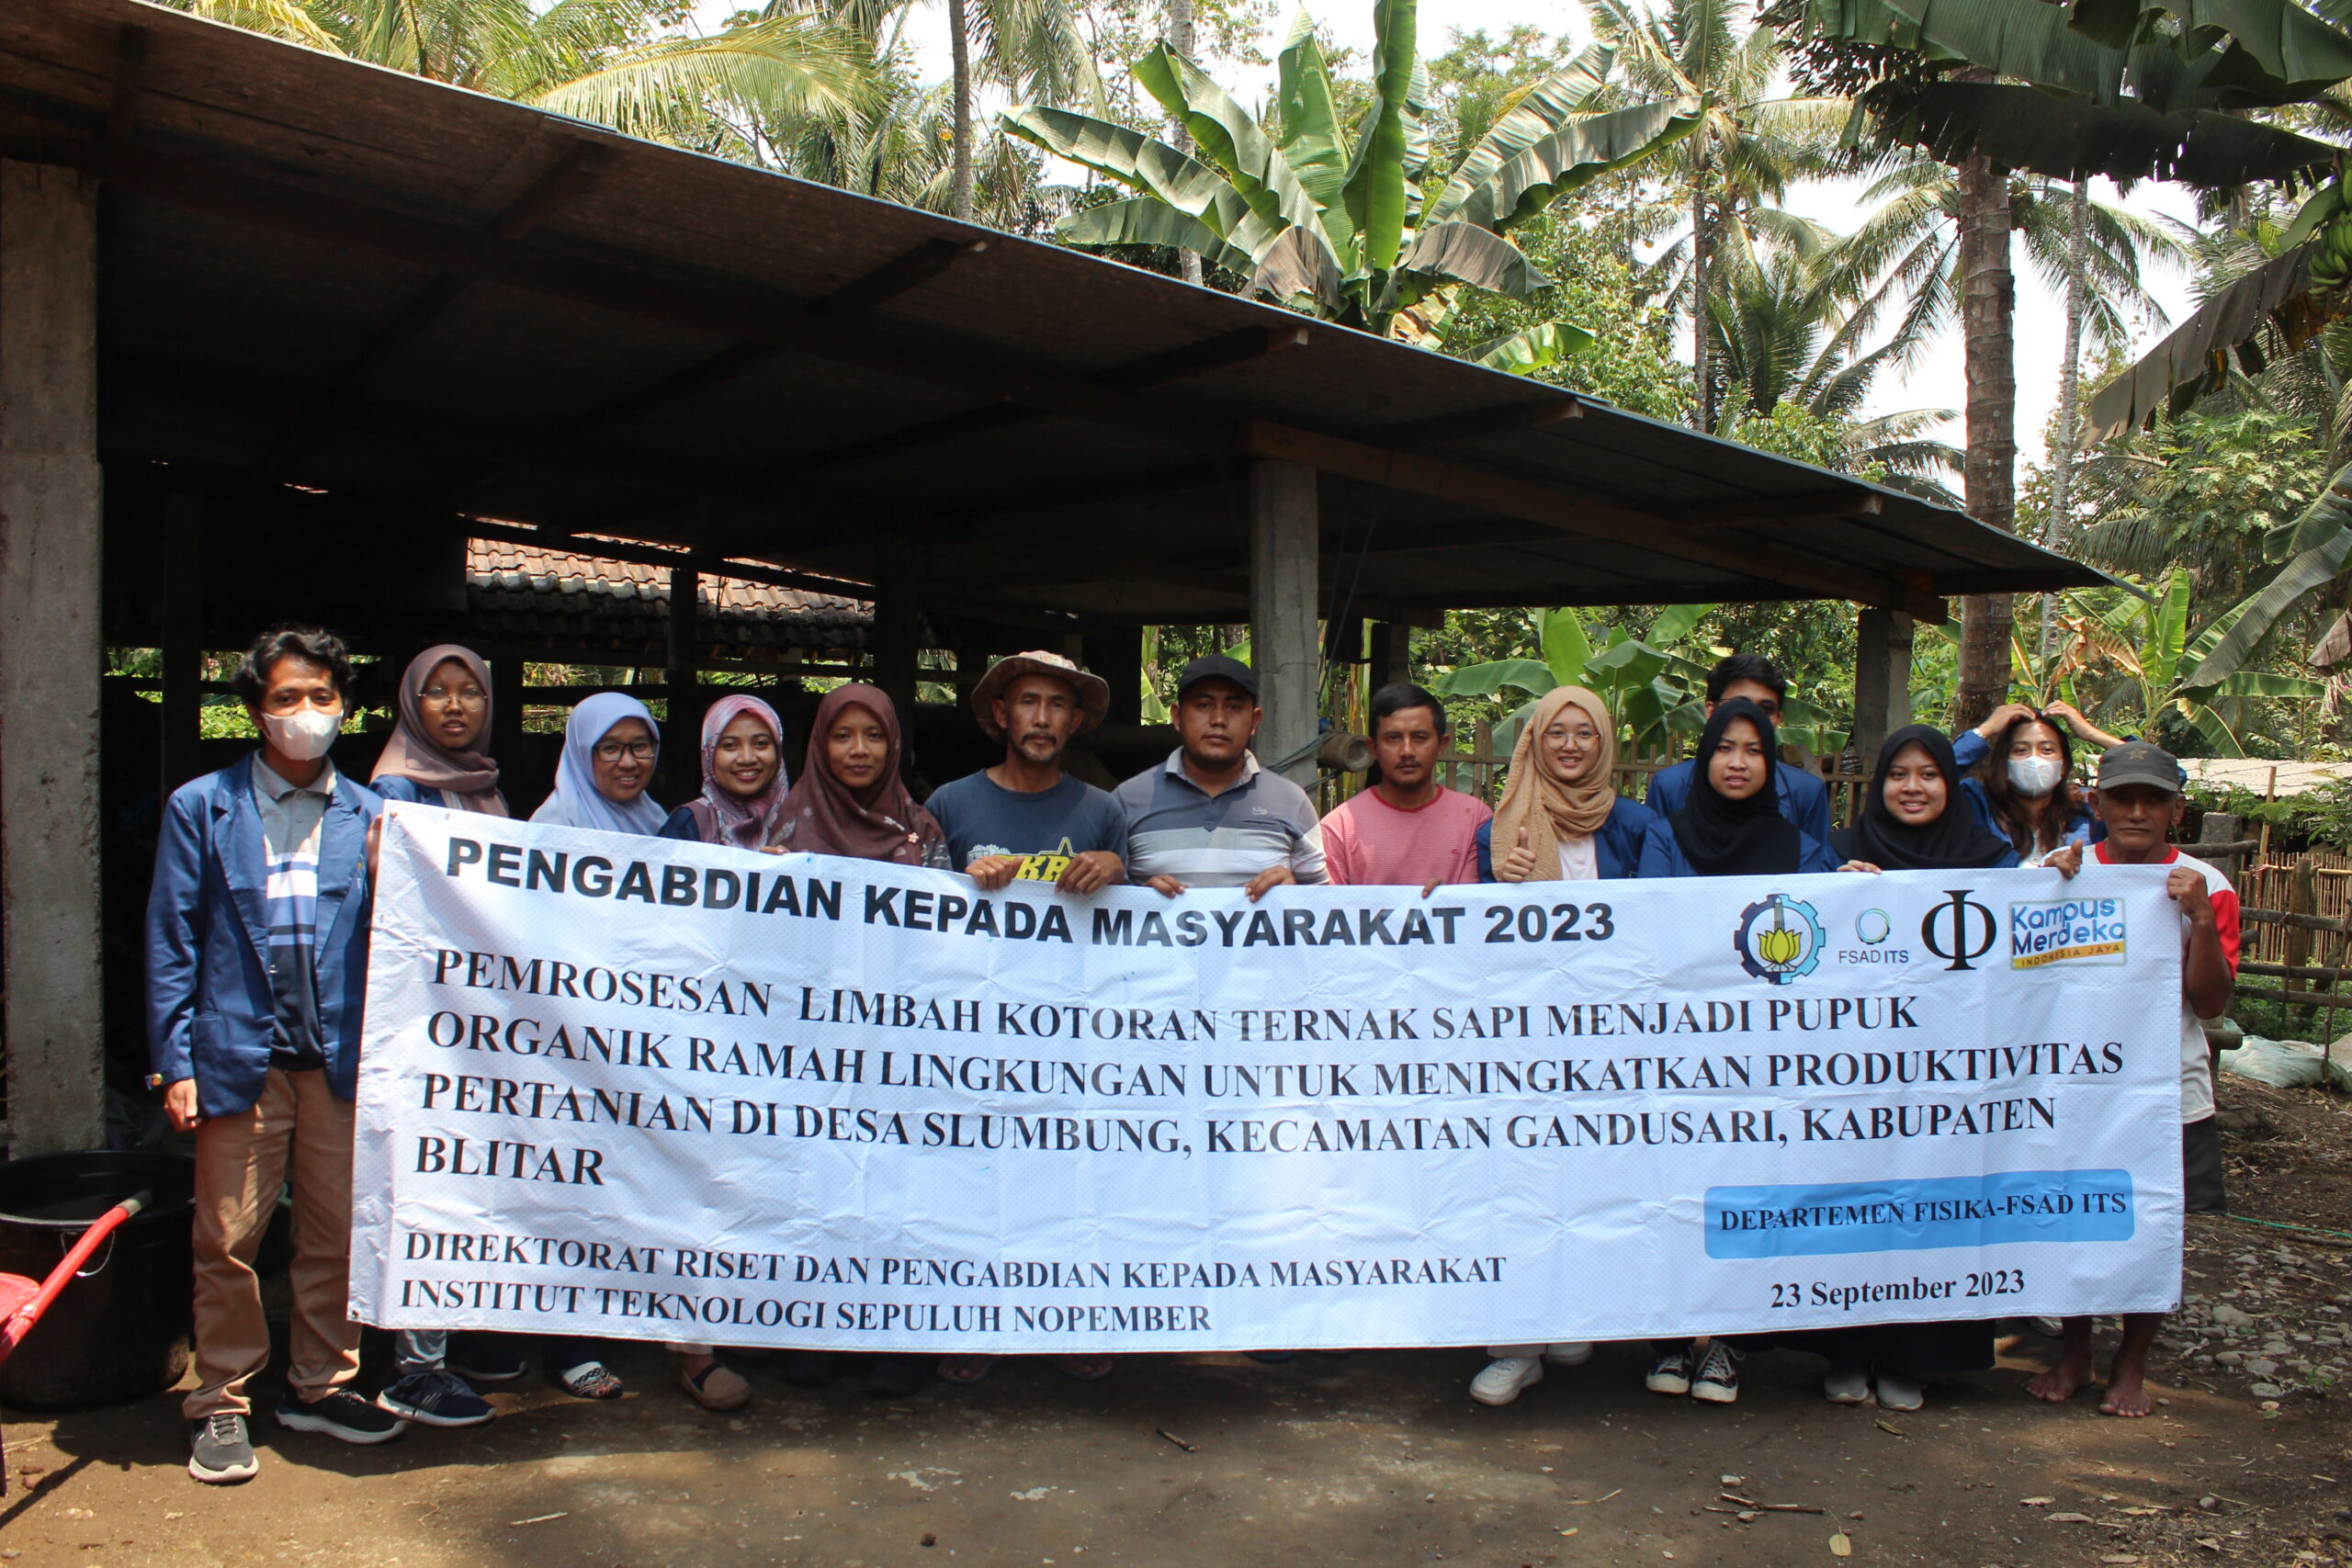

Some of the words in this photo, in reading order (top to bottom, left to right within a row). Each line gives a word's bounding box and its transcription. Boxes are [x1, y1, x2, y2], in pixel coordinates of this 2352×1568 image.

[447, 837, 842, 921] PENGABDIAN
[864, 884, 1074, 944] KEPADA
[1091, 907, 1465, 948] MASYARAKAT
[1484, 902, 1615, 943] 2023
[2011, 898, 2116, 931] Kampus
[1838, 949, 1881, 964] FSAD
[1884, 950, 1909, 964] ITS
[2012, 919, 2125, 955] Merdeka
[2021, 949, 2080, 967] INDONESIA
[2088, 944, 2120, 955] JAYA
[434, 949, 774, 1018] PEMROSESAN
[797, 986, 980, 1033] LIMBAH
[998, 1002, 1216, 1041] KOTORAN
[1232, 1009, 1419, 1042] TERNAK
[1432, 1006, 1530, 1039] SAPI
[1547, 1000, 1751, 1037] MENJADI
[1768, 996, 1919, 1032] PUPUK
[427, 1010, 671, 1069] ORGANIK
[688, 1037, 865, 1084] RAMAH
[878, 1051, 1185, 1097] LINGKUNGAN
[1204, 1064, 1360, 1098] UNTUK
[1374, 1055, 1751, 1095] MENINGKATKAN
[1767, 1042, 2123, 1087] PRODUKTIVITAS
[423, 1073, 712, 1134] PERTANIAN
[729, 1100, 778, 1136] DI
[794, 1104, 910, 1145] DESA
[922, 1111, 1192, 1159] SLUMBUNG,
[1207, 1117, 1490, 1153] KECAMATAN
[1507, 1110, 1788, 1148] GANDUSARI,
[1802, 1097, 2056, 1142] KABUPATEN
[415, 1136, 604, 1186] BLITAR
[1721, 1201, 1905, 1231] DEPARTEMEN
[1914, 1193, 2074, 1223] FISIKA-FSAD
[2082, 1192, 2126, 1213] ITS
[406, 1232, 664, 1275] DIREKTORAT
[672, 1248, 785, 1281] RISET
[794, 1255, 871, 1284] DAN
[880, 1258, 1110, 1288] PENGABDIAN
[1124, 1262, 1261, 1288] KEPADA
[1271, 1257, 1507, 1287] MASYARAKAT
[401, 1280, 585, 1314] INSTITUT
[594, 1287, 826, 1329] TEKNOLOGI
[836, 1302, 1001, 1332] SEPULUH
[1014, 1305, 1211, 1332] NOPEMBER
[1770, 1282, 1802, 1309] 23
[1811, 1276, 1958, 1312] September
[1964, 1269, 2025, 1298] 2023
